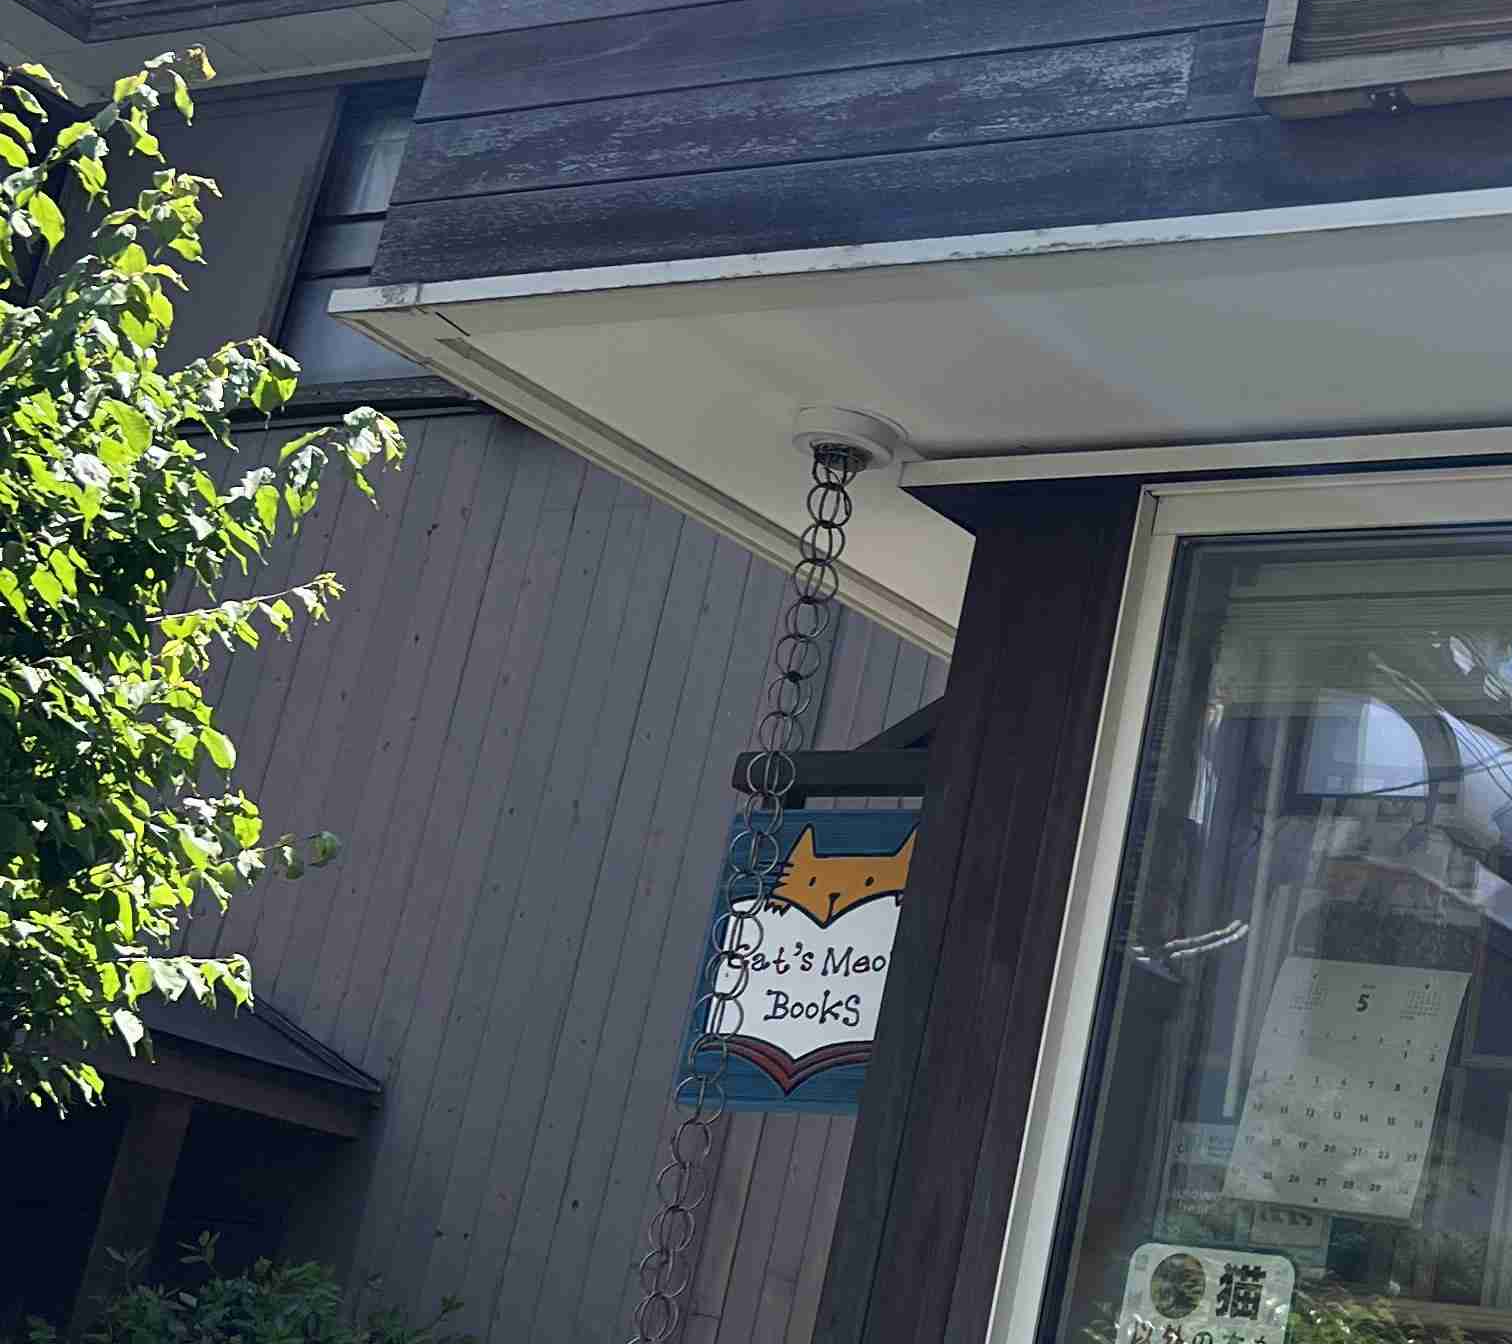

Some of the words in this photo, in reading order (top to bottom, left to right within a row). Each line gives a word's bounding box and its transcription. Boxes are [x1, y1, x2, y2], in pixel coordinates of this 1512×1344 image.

[820, 946, 888, 977] Meo
[1356, 993, 1370, 1012] 5
[1215, 1262, 1267, 1321] 猫
